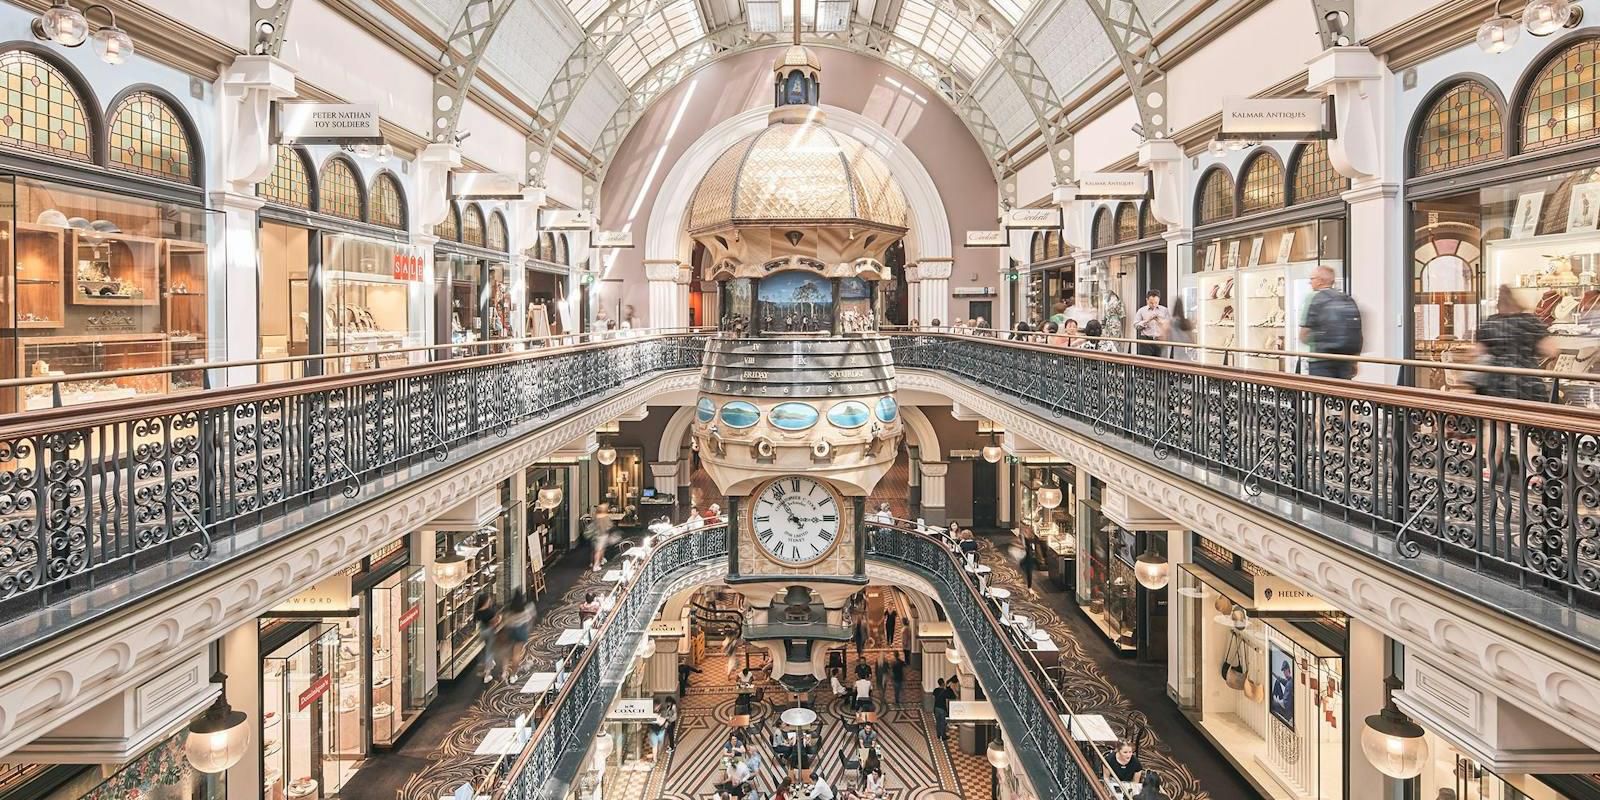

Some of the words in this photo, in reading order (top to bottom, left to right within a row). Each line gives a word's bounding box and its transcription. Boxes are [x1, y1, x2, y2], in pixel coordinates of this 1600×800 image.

[395, 261, 423, 276] SALE
[743, 370, 769, 380] FRIDAY
[828, 369, 865, 379] SATURDAY
